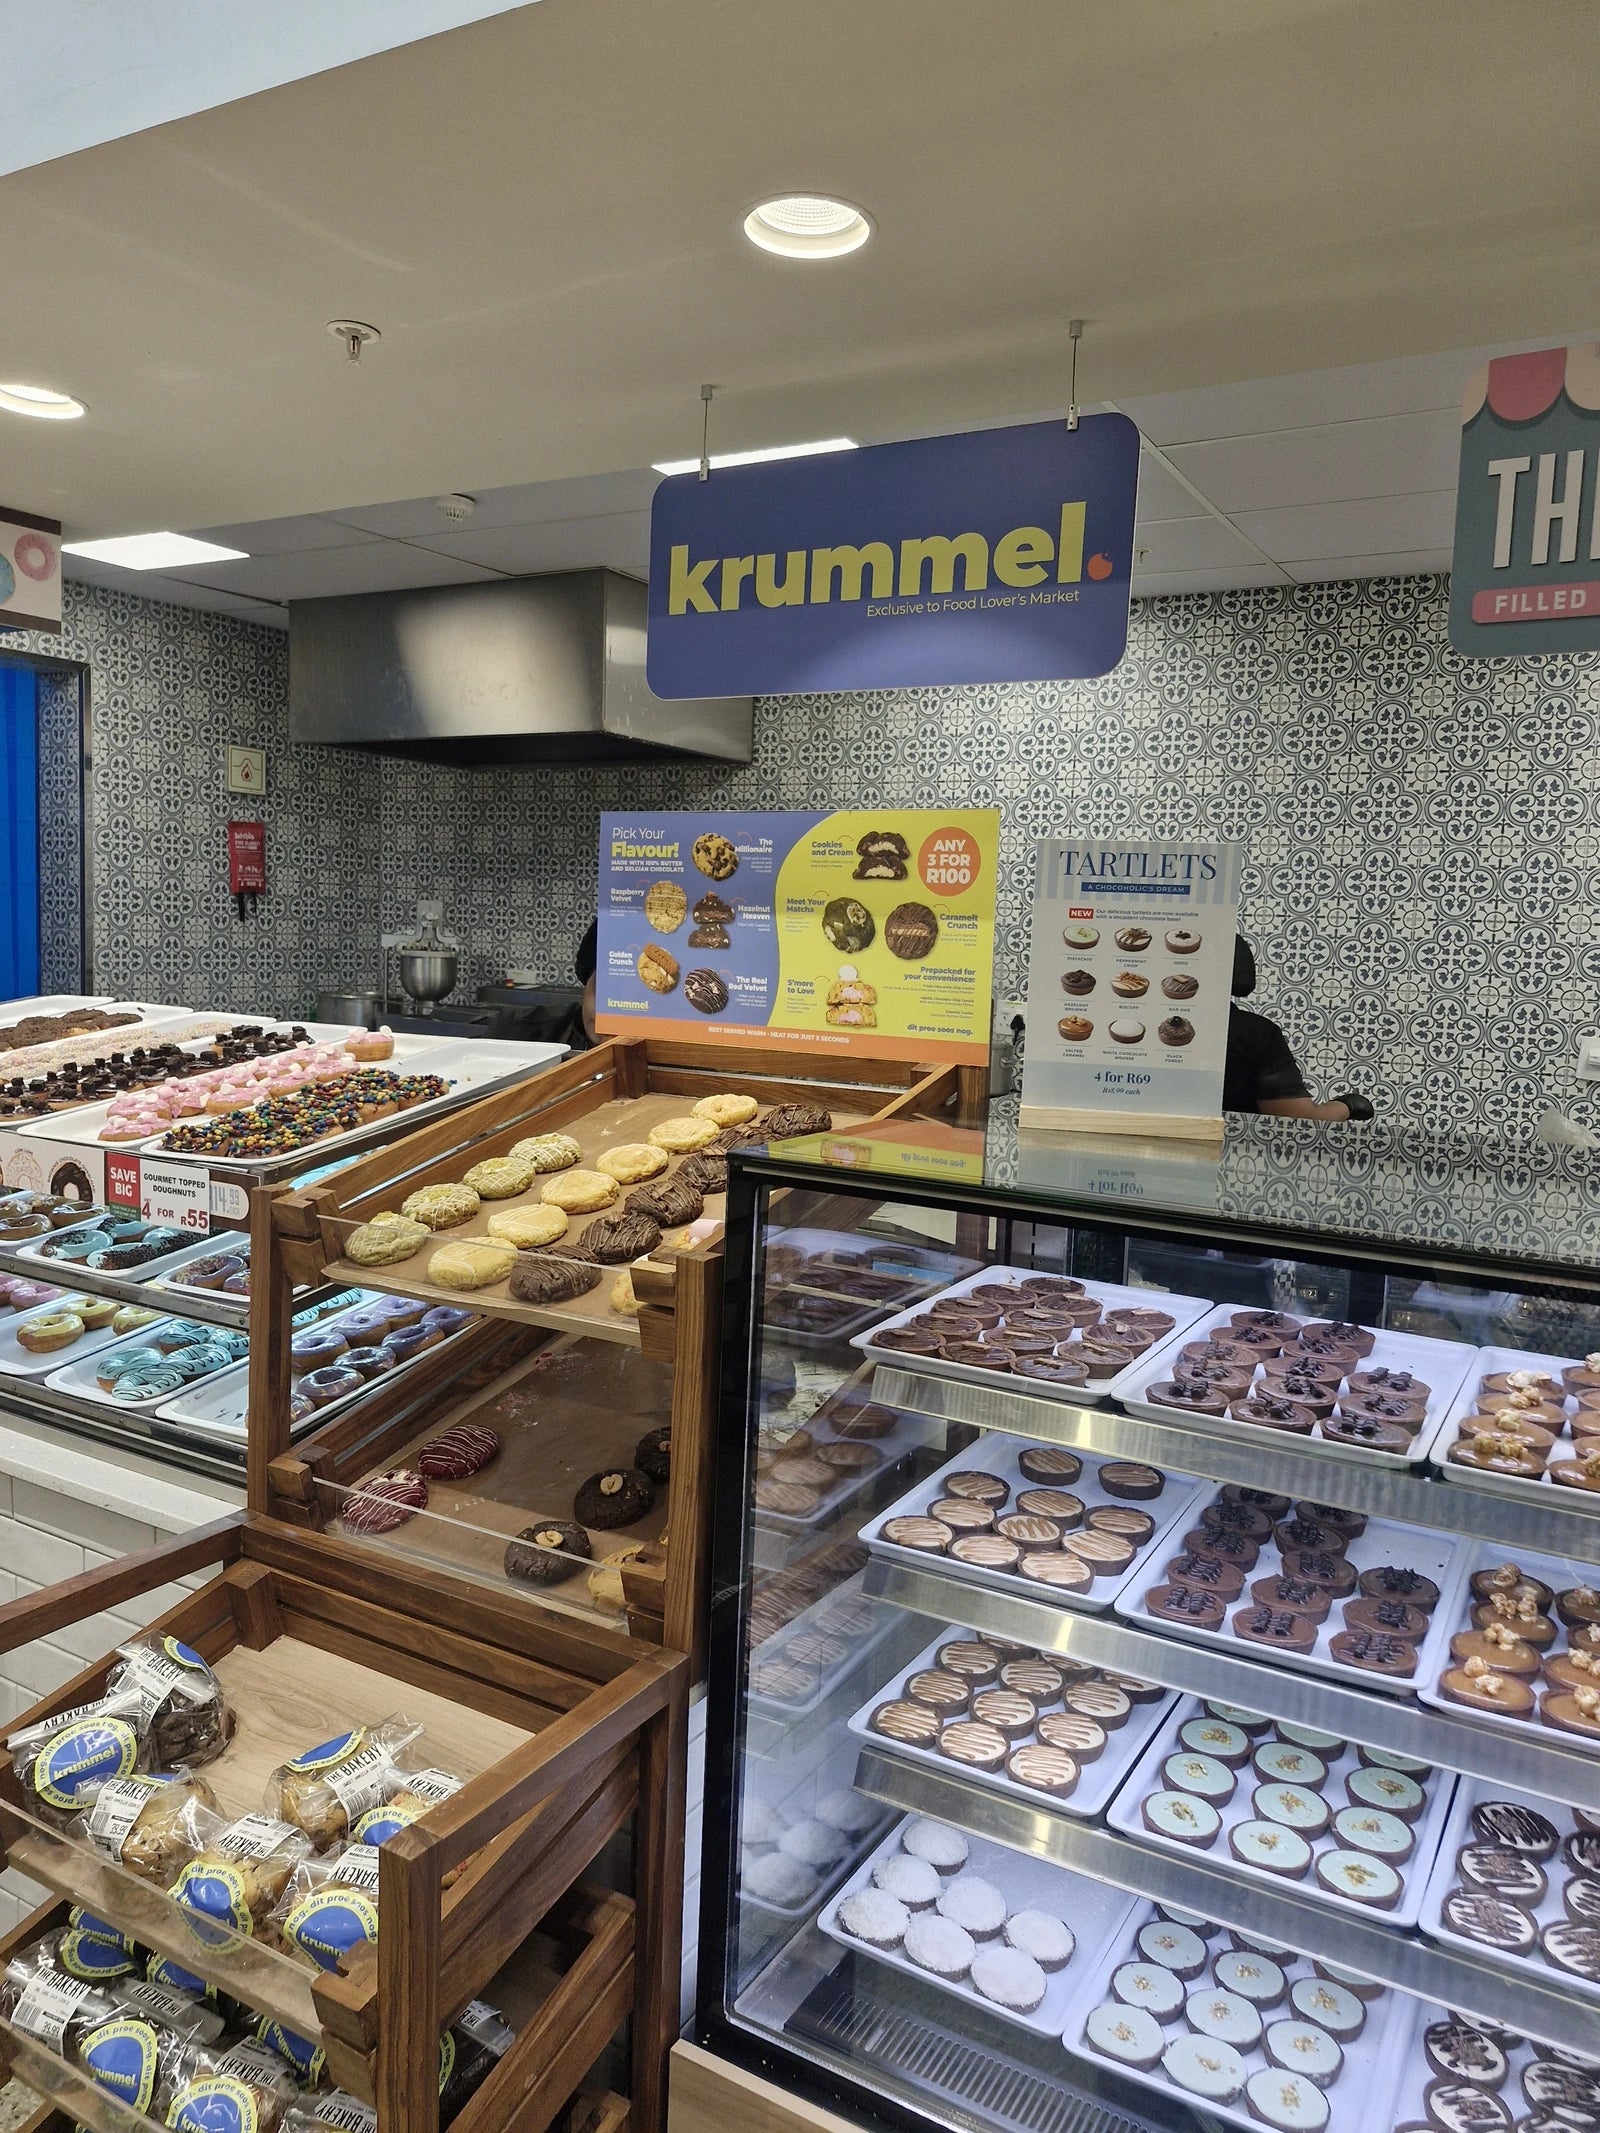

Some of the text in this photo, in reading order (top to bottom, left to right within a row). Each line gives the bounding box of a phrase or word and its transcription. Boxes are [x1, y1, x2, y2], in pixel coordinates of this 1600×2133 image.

[1488, 449, 1600, 569] TH
[867, 590, 1080, 617] Exclusive to Food Lover's Market
[1494, 588, 1587, 615] FILLED
[612, 827, 665, 840] Pick Your
[759, 838, 773, 846] The
[811, 841, 843, 849] Cookies
[933, 840, 967, 852] ANY
[611, 841, 679, 859] Flavour!
[734, 845, 773, 854] Millionaire
[811, 848, 854, 857] and Cream
[927, 854, 971, 867] 3 FOR
[1059, 851, 1217, 880] TARTLETS
[926, 868, 971, 885] R100
[611, 888, 645, 897] Raspberry
[738, 904, 771, 912] Hazelnut
[786, 898, 826, 906] Meet Your
[786, 905, 815, 913] Matcha
[742, 912, 770, 920] Heaven
[947, 921, 978, 930] Crunch
[608, 951, 633, 959] Golden
[608, 957, 634, 966] Crunch
[920, 966, 976, 977] Prepacked for
[736, 975, 768, 984] The Real
[787, 979, 814, 988] S'more
[903, 974, 976, 984] your convenience:
[728, 983, 768, 992] Red Velvet
[787, 987, 816, 995] to Love
[723, 1027, 746, 1035] SERVED
[820, 1035, 850, 1043] SECONDS
[937, 1026, 955, 1034] soos
[1094, 1071, 1151, 1085] 4 for R69
[110, 1167, 137, 1183] SAVE
[143, 1173, 206, 1189] GOURMET TOPPED
[115, 1182, 133, 1197] BIG
[152, 1185, 196, 1198] DOUGHNUTS
[141, 1201, 152, 1219] 4
[157, 1207, 175, 1218] FOR
[180, 1208, 209, 1229] R55
[140, 1649, 154, 1660] THE
[147, 1655, 184, 1682] BAKERY
[43, 1705, 89, 1731] BAKERY
[326, 1771, 343, 1783] THE
[340, 1744, 382, 1777] BAKERY
[217, 1833, 262, 1855] BAKERY
[191, 1864, 204, 1874] dit
[288, 1908, 308, 1930] nog.
[309, 1899, 325, 1909] dit
[366, 1916, 378, 1941] nog.
[39, 1968, 52, 1980] THE
[46, 1971, 90, 1999] BAKERY
[132, 1984, 173, 2011] BAKERY
[463, 2014, 480, 2028] THE
[219, 2056, 264, 2082] BAKERY
[197, 2082, 213, 2092] dit
